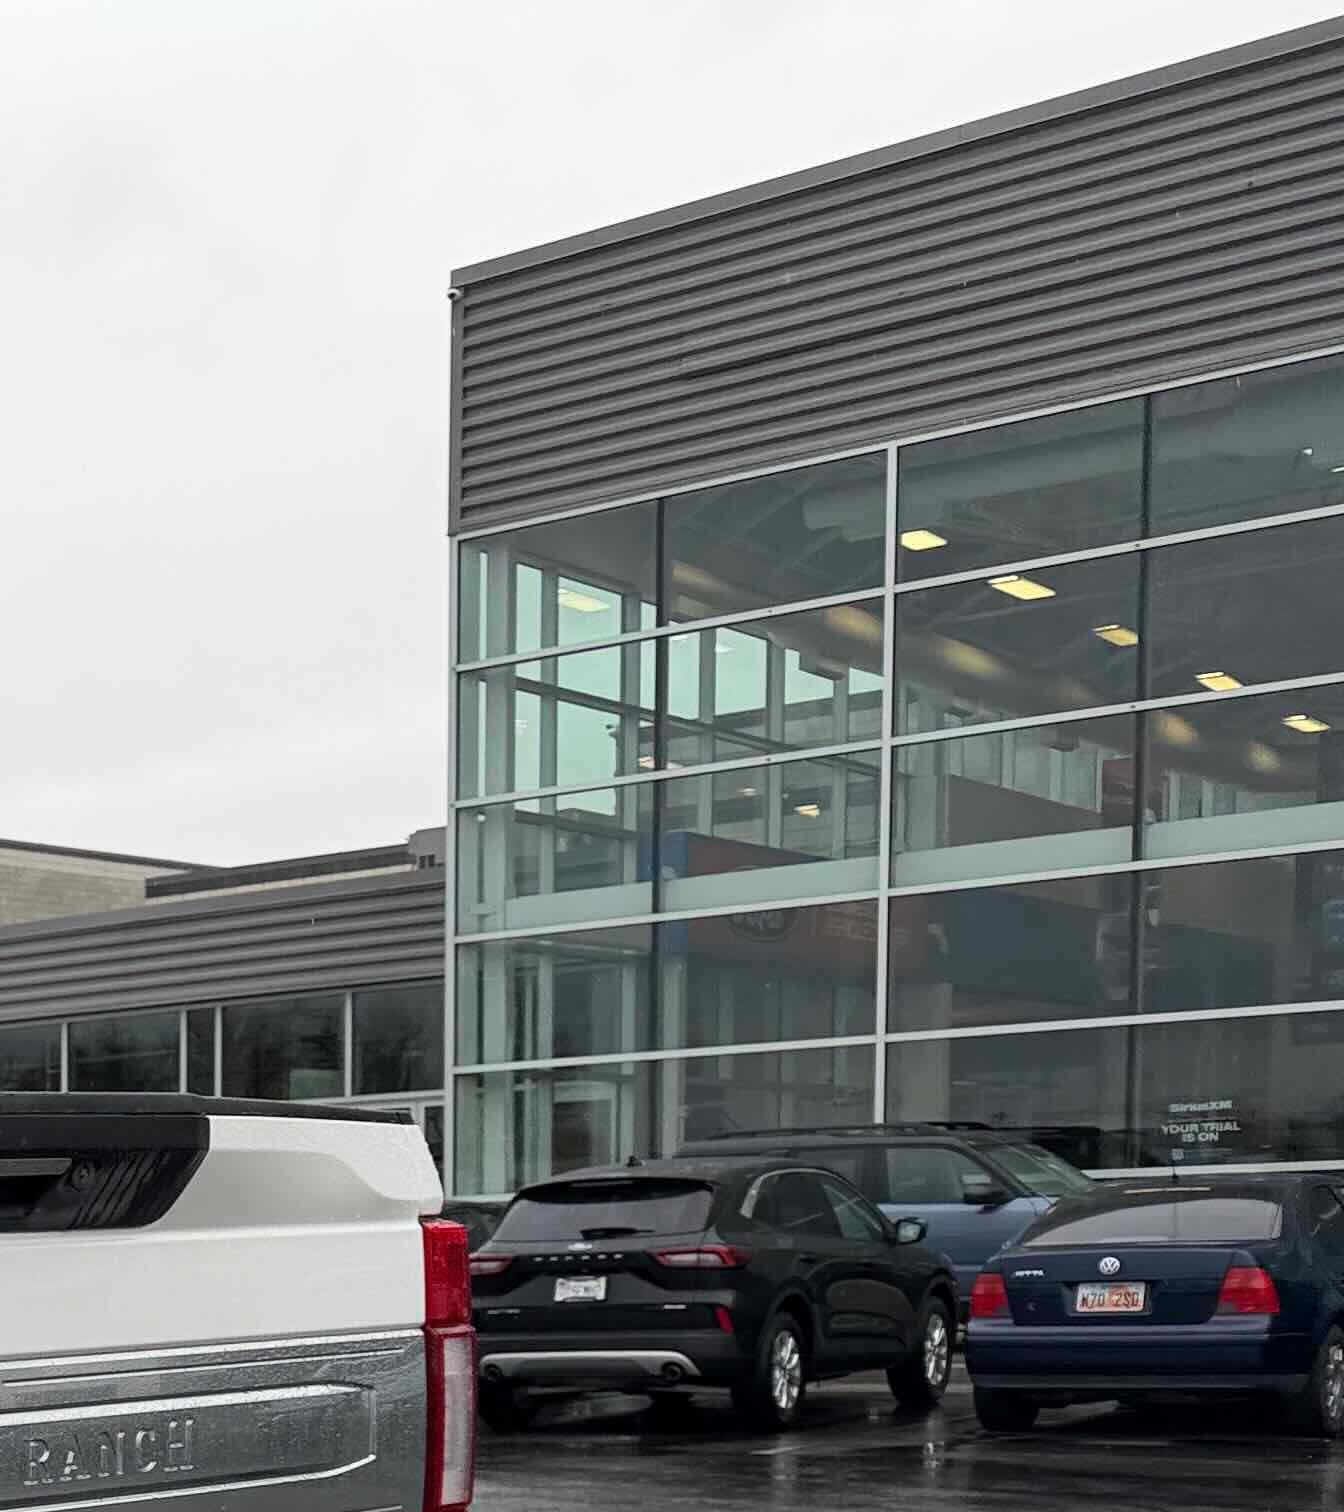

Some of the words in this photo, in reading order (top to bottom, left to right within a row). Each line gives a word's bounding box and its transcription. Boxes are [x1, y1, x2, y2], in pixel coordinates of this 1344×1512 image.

[1162, 1123, 1199, 1135] YOUR
[1202, 1120, 1241, 1132] TRIAL
[1182, 1134, 1195, 1143] IS
[1198, 1132, 1219, 1142] ON
[22, 1417, 196, 1487] RANCH
